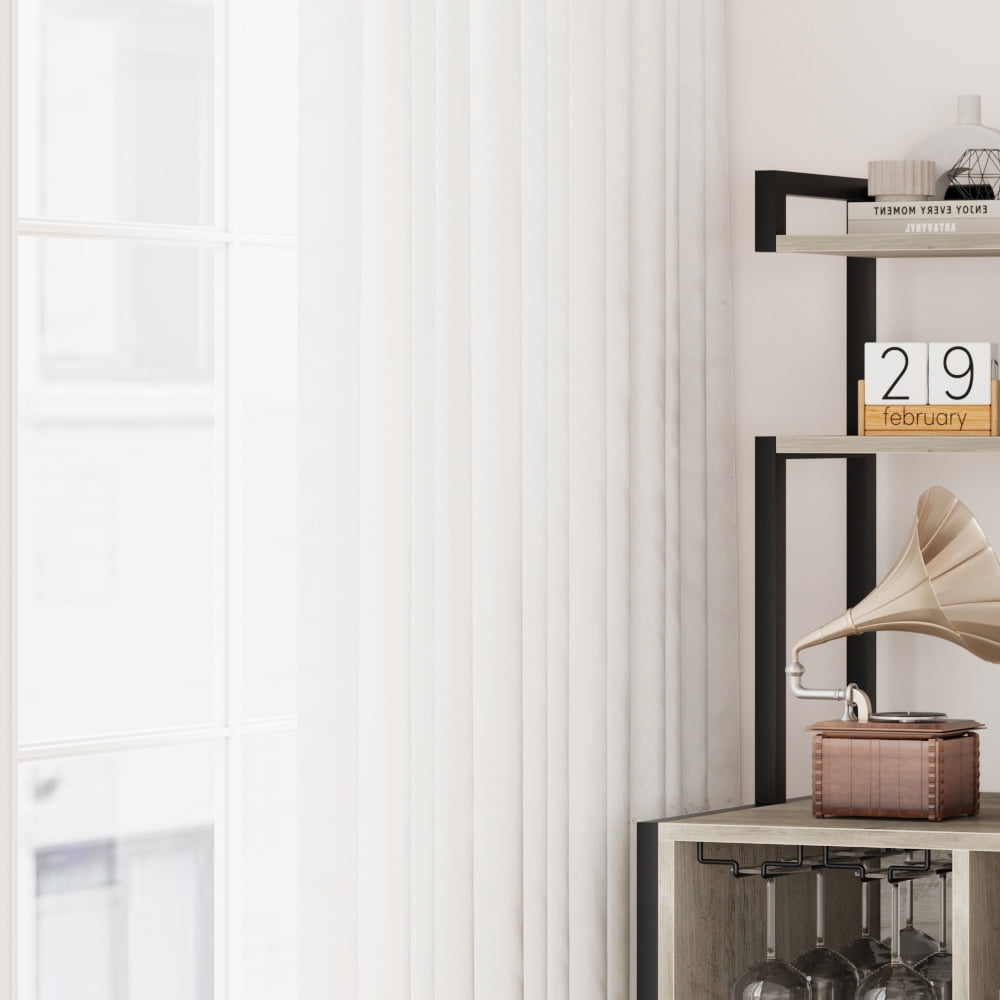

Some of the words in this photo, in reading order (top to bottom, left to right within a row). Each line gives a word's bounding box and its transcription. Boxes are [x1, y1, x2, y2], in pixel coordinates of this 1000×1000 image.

[881, 346, 909, 400] 2
[943, 346, 974, 400] 9
[883, 406, 967, 431] february
